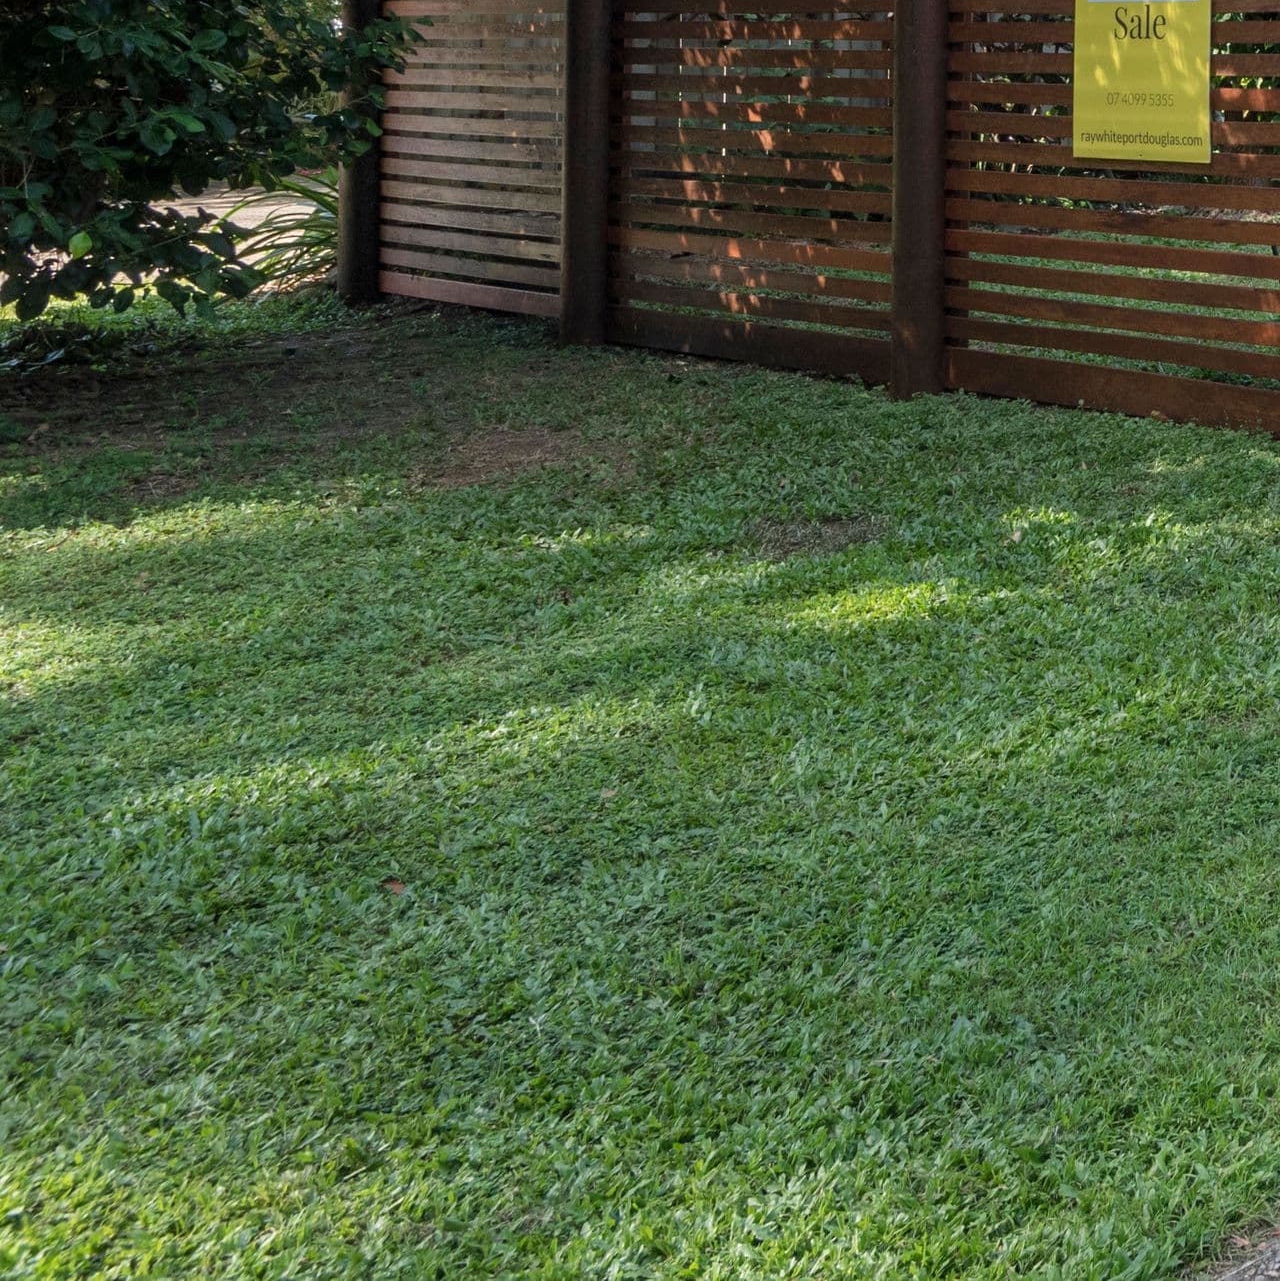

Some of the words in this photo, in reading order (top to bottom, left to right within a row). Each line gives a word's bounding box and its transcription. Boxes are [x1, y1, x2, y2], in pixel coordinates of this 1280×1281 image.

[1114, 4, 1166, 40] Sale
[1106, 92, 1120, 106] 07
[1080, 130, 1203, 148] raywhiteportdouglas.com
